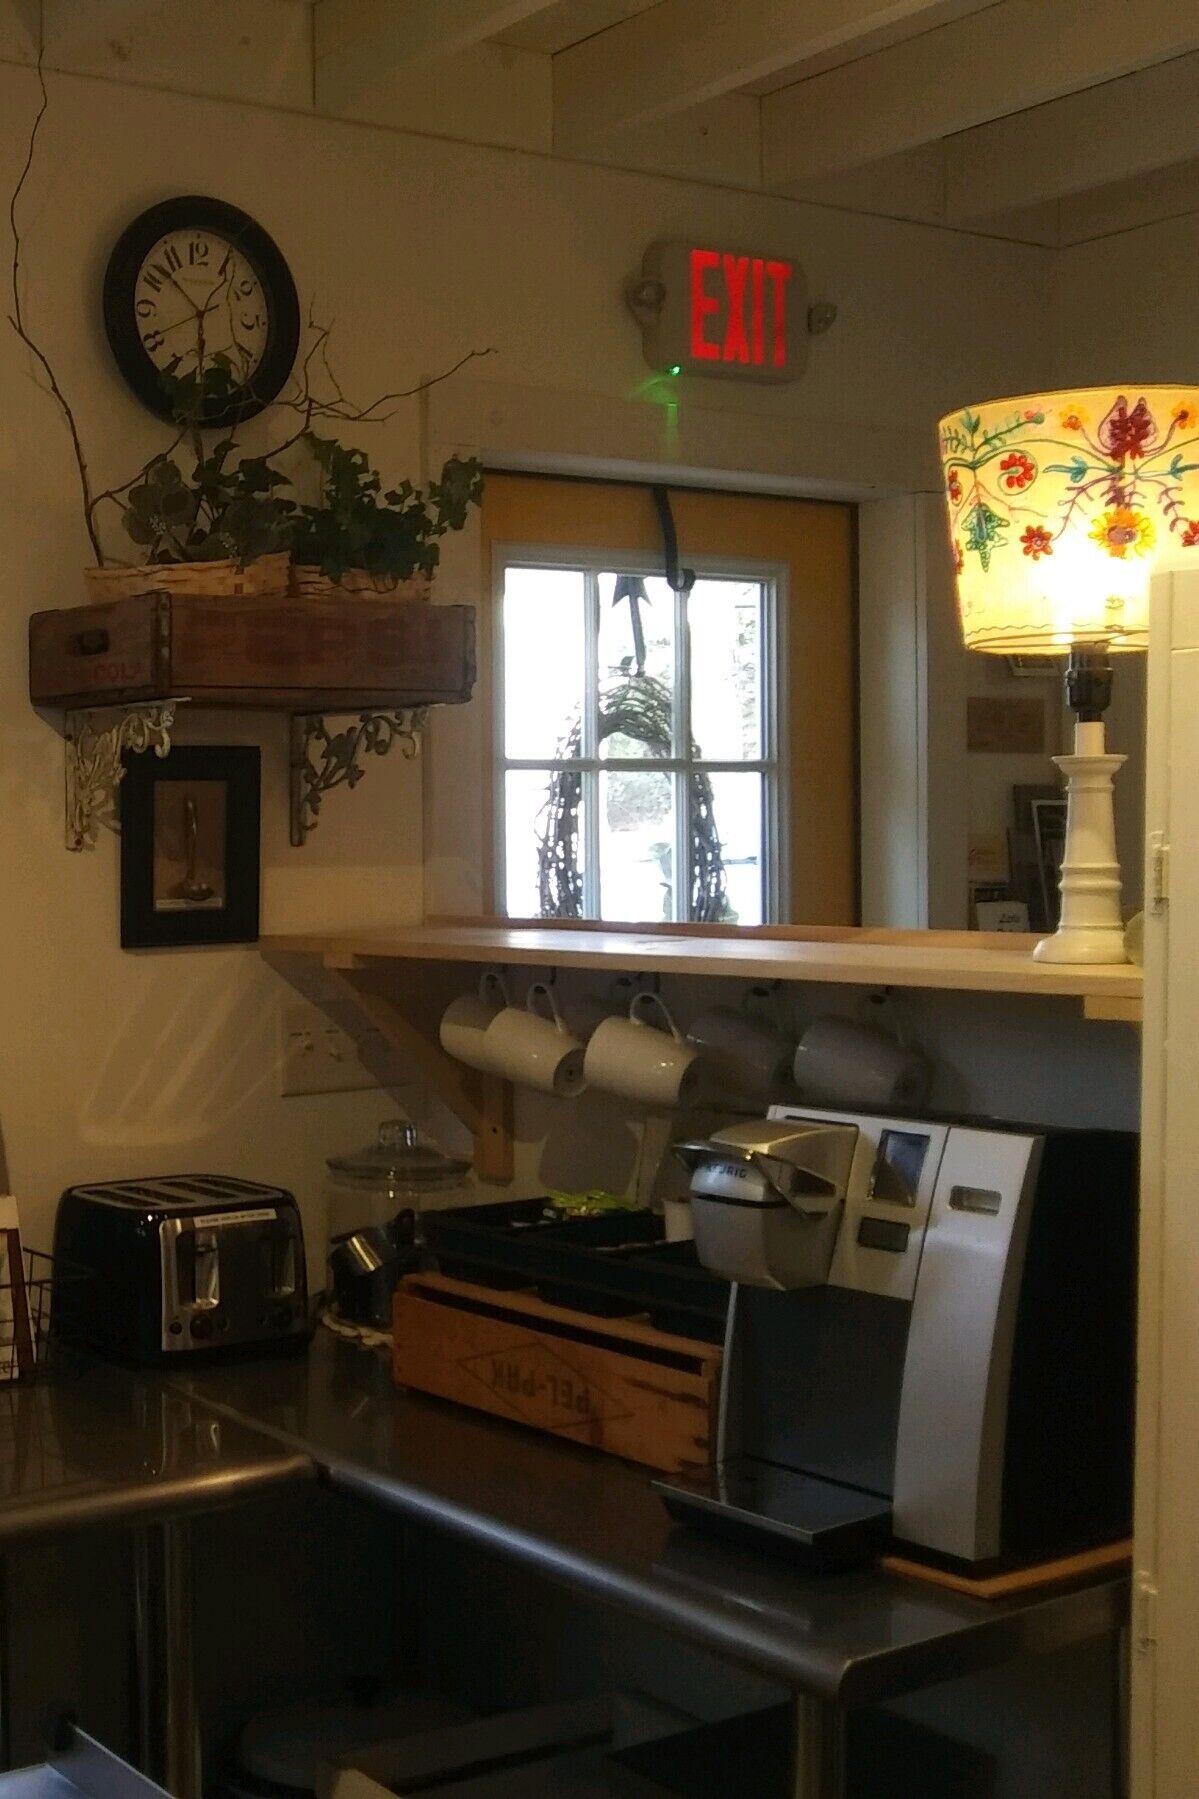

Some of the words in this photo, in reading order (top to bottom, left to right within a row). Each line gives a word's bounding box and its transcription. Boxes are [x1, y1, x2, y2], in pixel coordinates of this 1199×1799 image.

[188, 241, 209, 266] 12
[136, 298, 156, 319] 9
[689, 248, 793, 369] EXIT
[143, 329, 165, 353] 8
